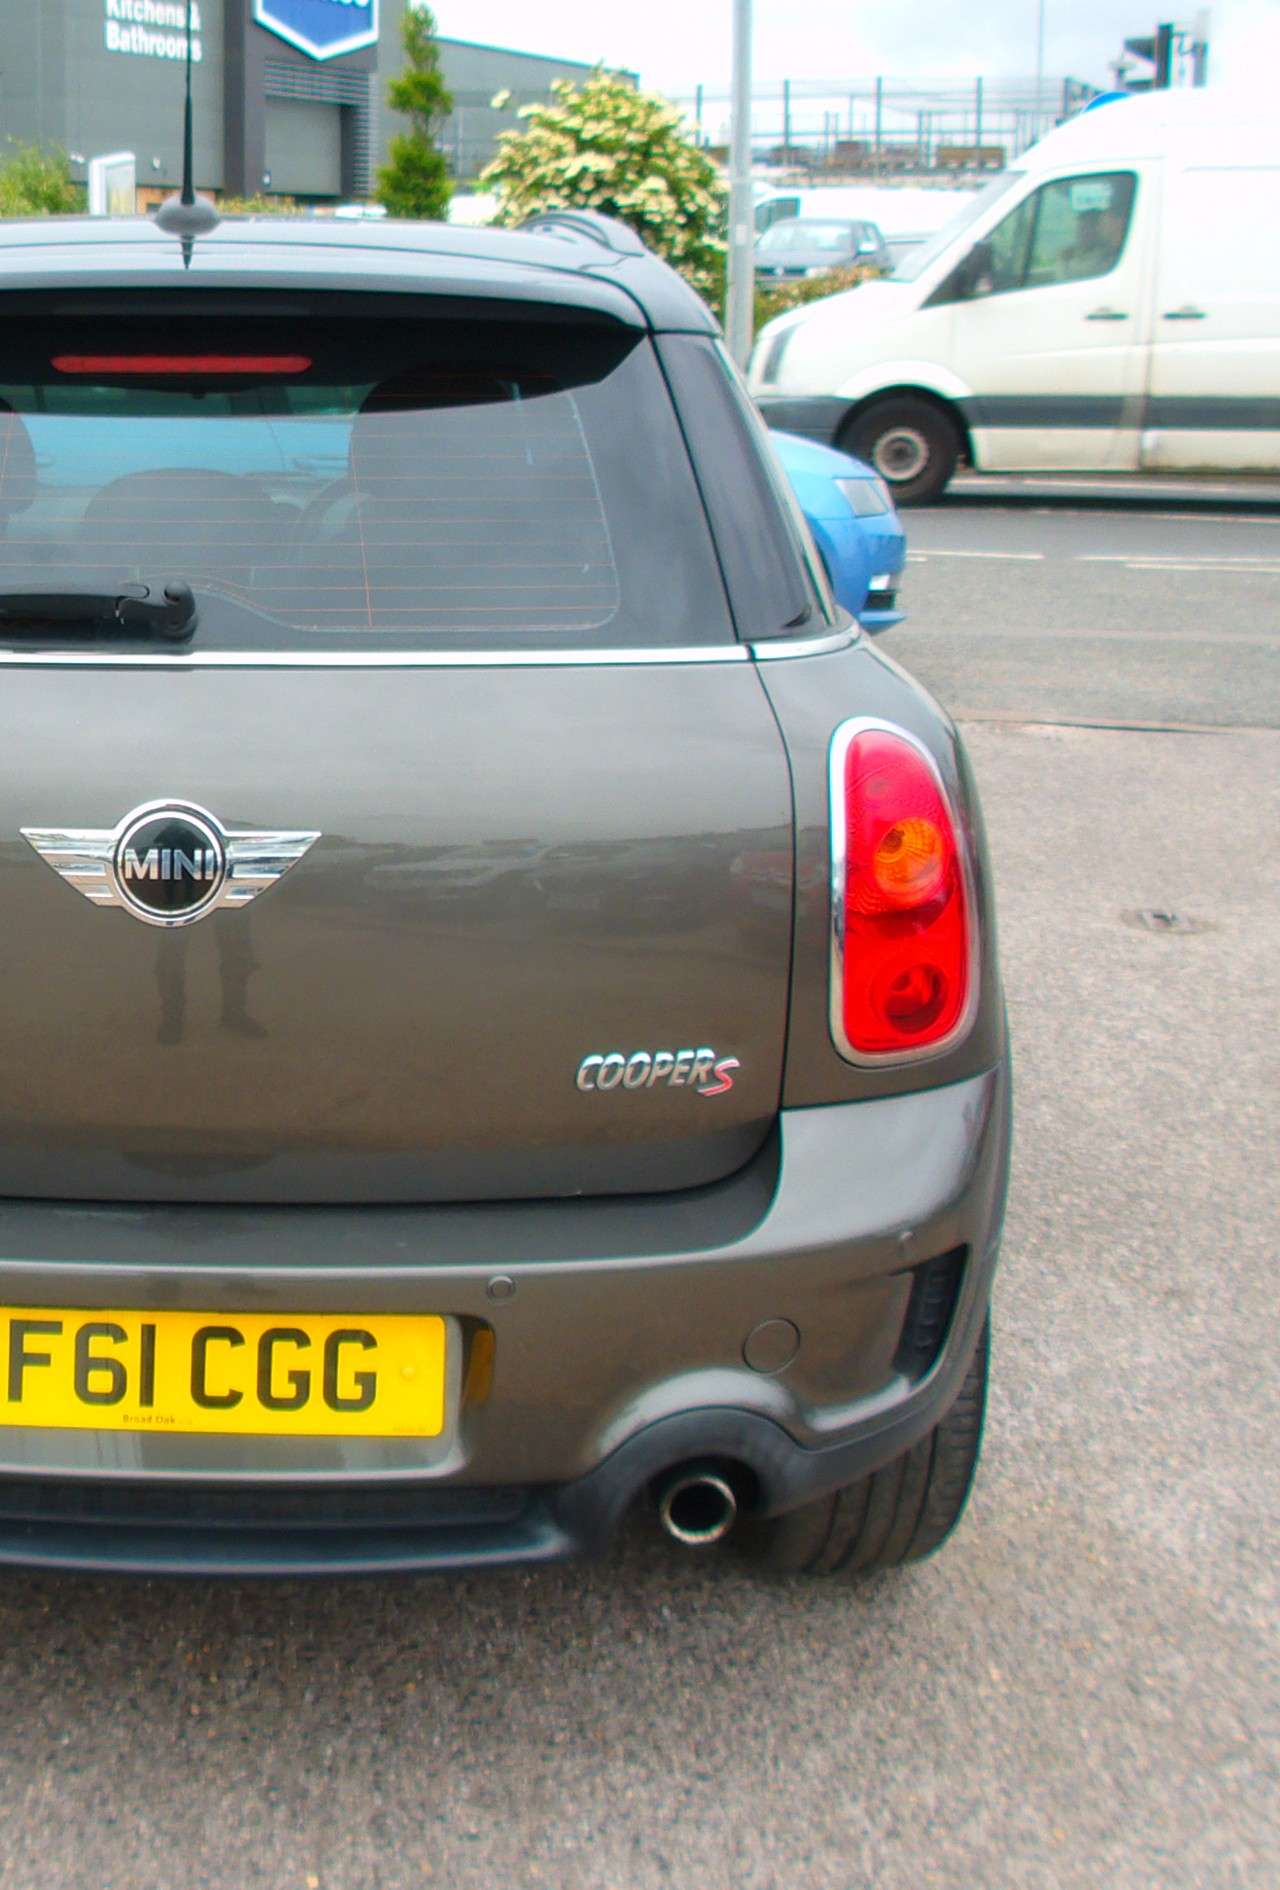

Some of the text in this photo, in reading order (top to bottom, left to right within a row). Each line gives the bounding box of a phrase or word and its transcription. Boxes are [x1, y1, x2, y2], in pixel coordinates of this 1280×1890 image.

[106, 20, 203, 62] Bathrooms
[124, 847, 215, 880] MINI
[577, 1048, 716, 1090] COOPER
[190, 1325, 378, 1413] CGG
